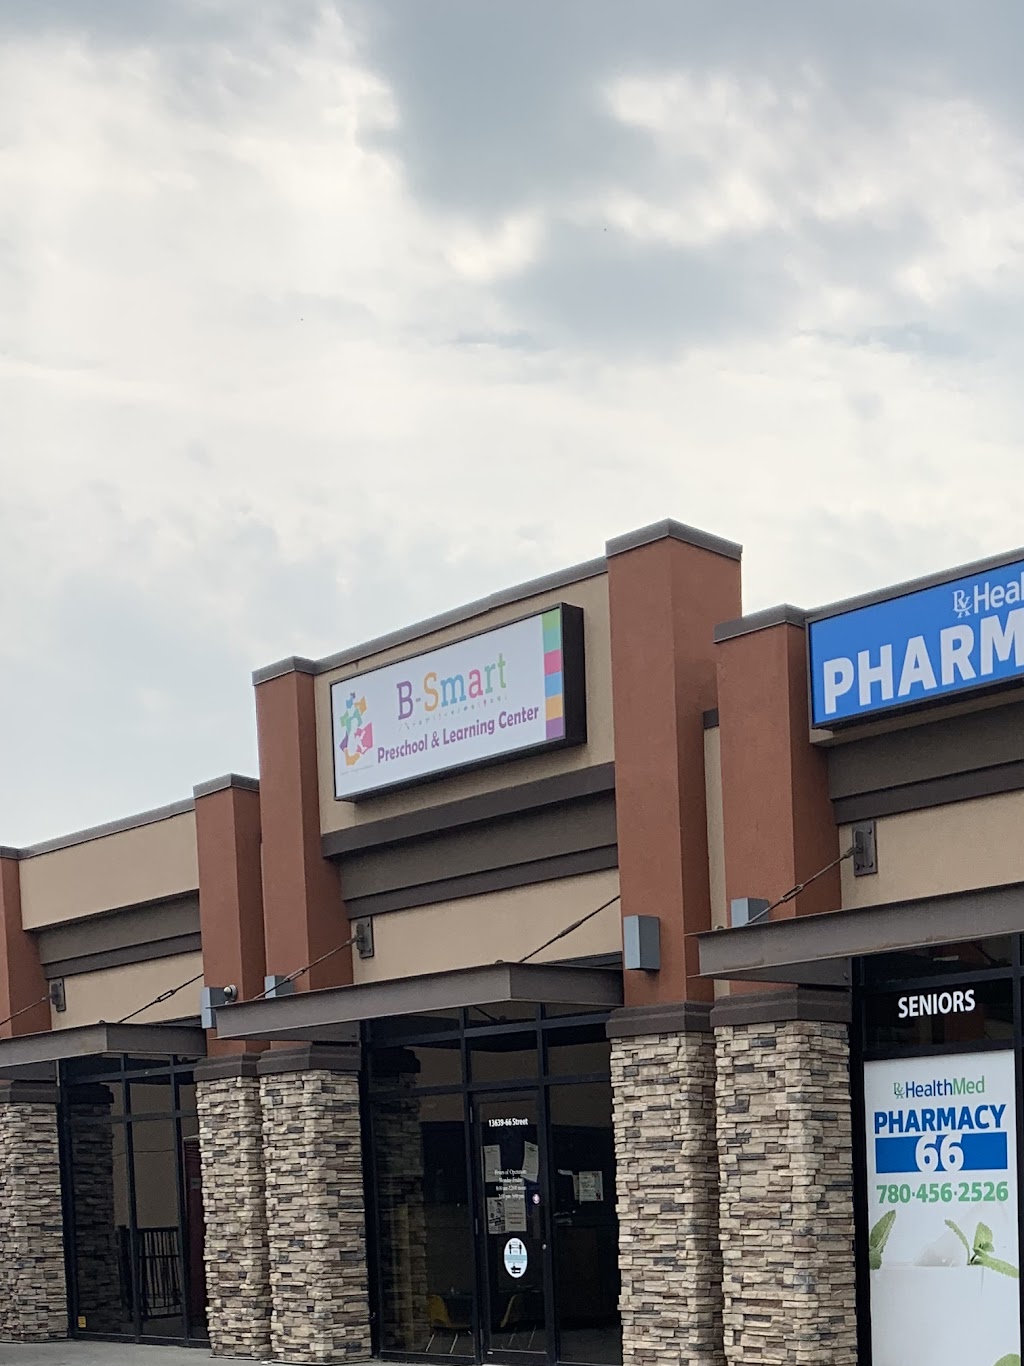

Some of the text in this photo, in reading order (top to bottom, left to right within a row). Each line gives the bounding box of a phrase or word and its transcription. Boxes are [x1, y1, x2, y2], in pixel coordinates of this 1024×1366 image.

[396, 653, 507, 721] B-Smart
[377, 733, 428, 764] Preschool
[431, 731, 440, 749] &
[443, 718, 495, 745] Learning
[498, 705, 540, 729] Center
[898, 989, 976, 1018] SENIORS
[512, 1117, 529, 1126] Street
[874, 1103, 1007, 1134] PHARMACY
[915, 1133, 965, 1172] 66
